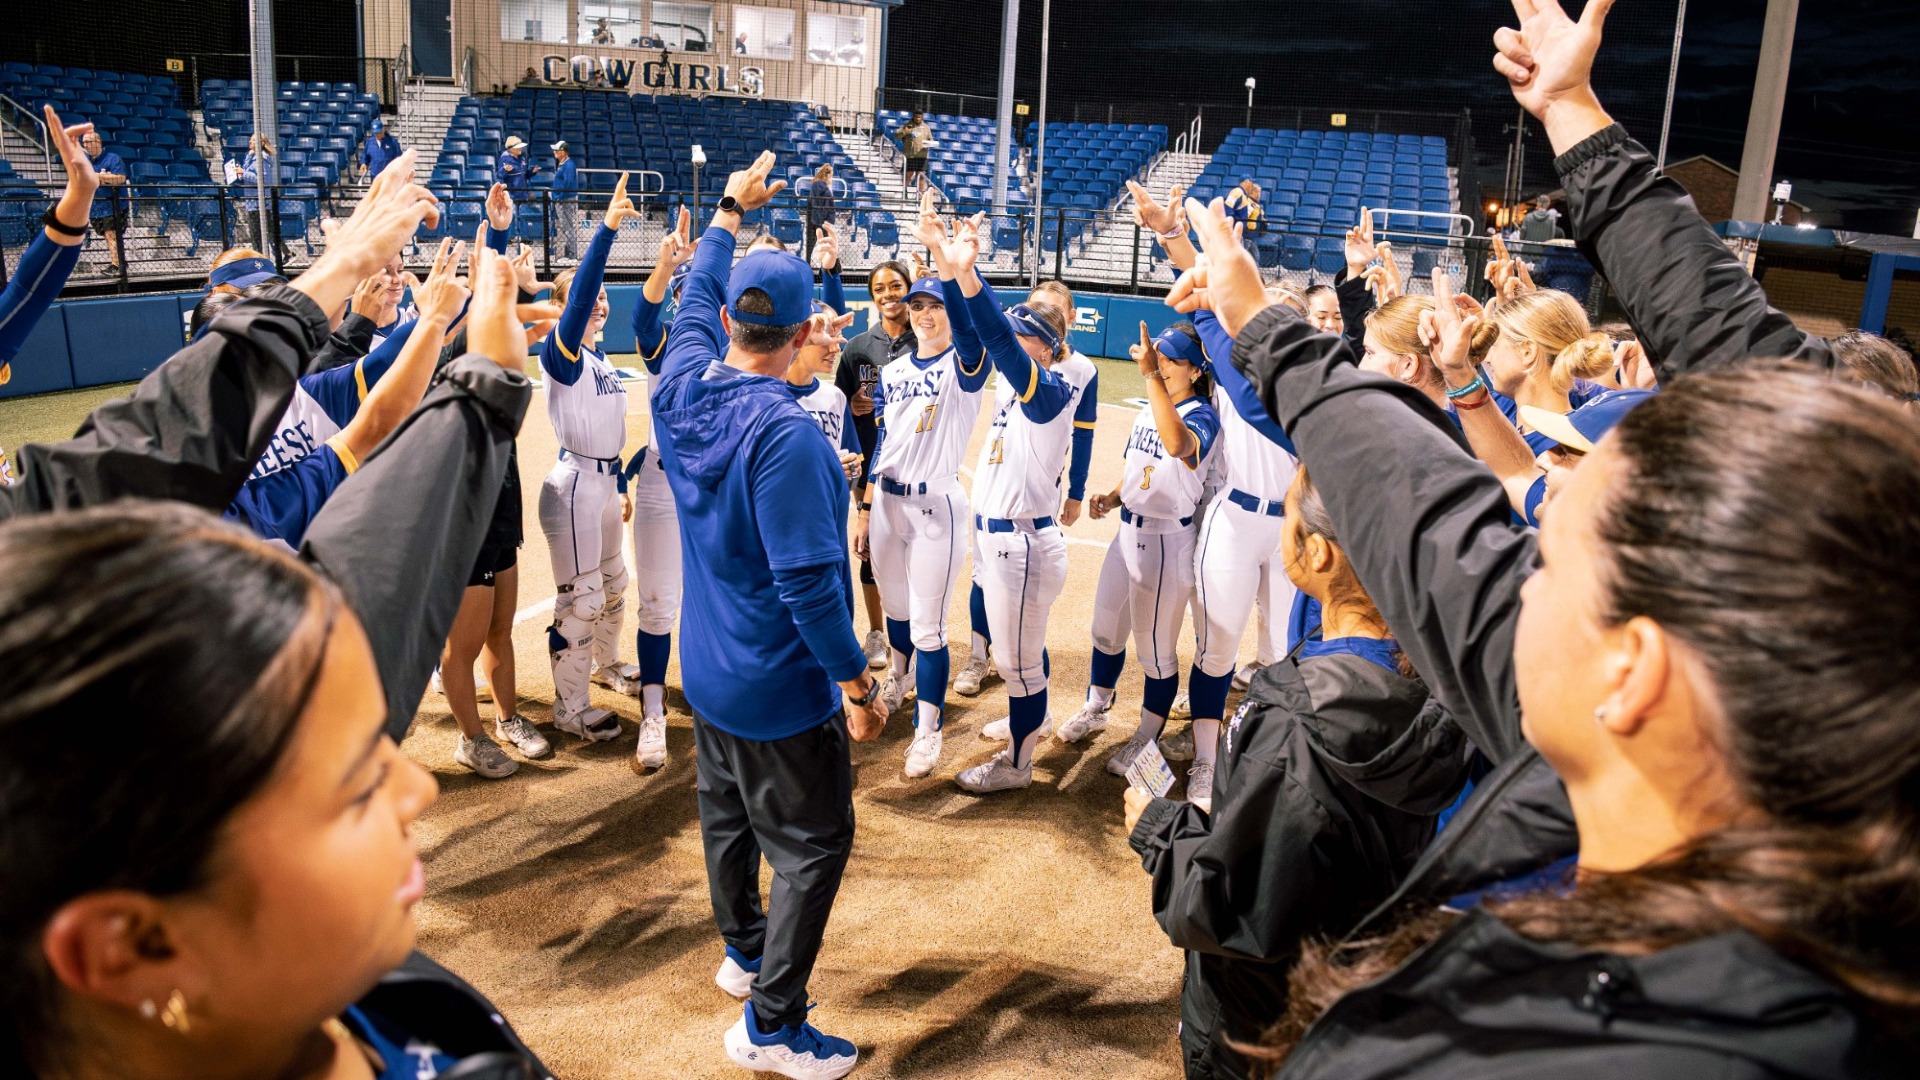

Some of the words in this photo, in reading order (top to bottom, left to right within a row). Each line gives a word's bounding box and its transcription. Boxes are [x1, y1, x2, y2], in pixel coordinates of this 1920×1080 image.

[542, 54, 765, 97] COWGIRLS
[915, 403, 939, 433] 17
[1140, 465, 1155, 490] 1
